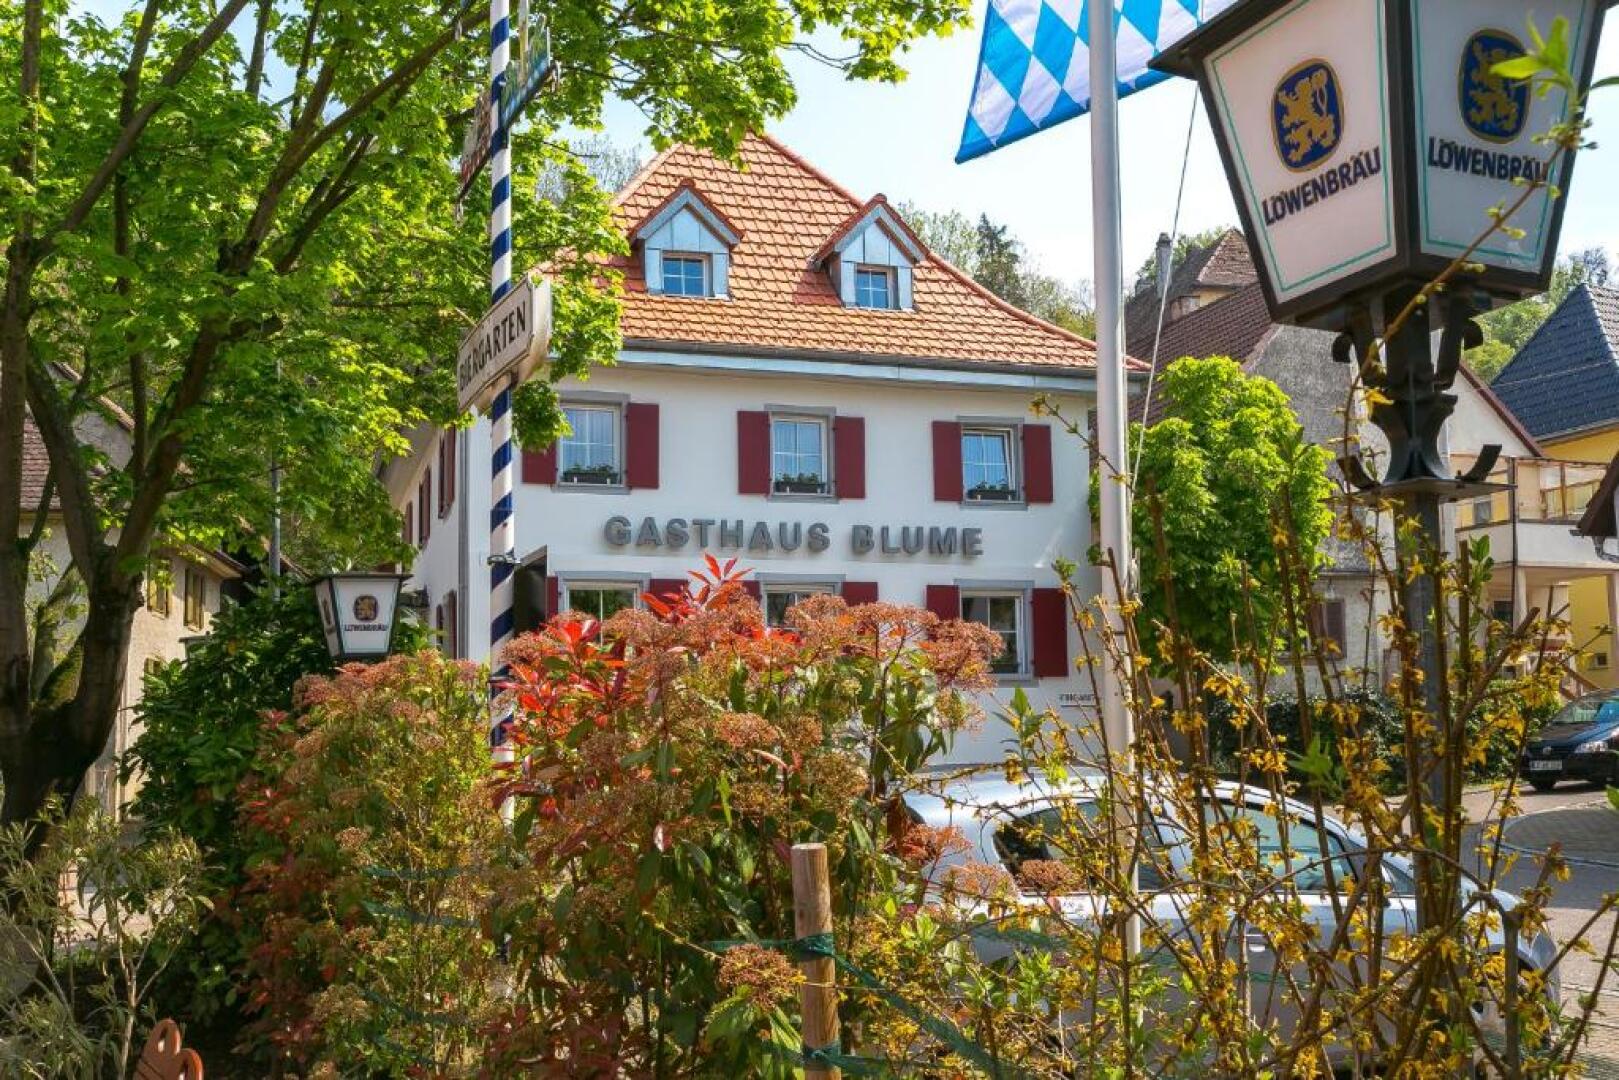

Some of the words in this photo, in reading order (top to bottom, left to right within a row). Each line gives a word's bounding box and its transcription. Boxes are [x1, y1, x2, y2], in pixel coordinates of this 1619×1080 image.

[1262, 146, 1381, 226] LÖWENBRÄU
[459, 301, 526, 391] BIERGARTEN
[603, 515, 831, 551] GASTHAUS
[852, 524, 984, 556] BLUME
